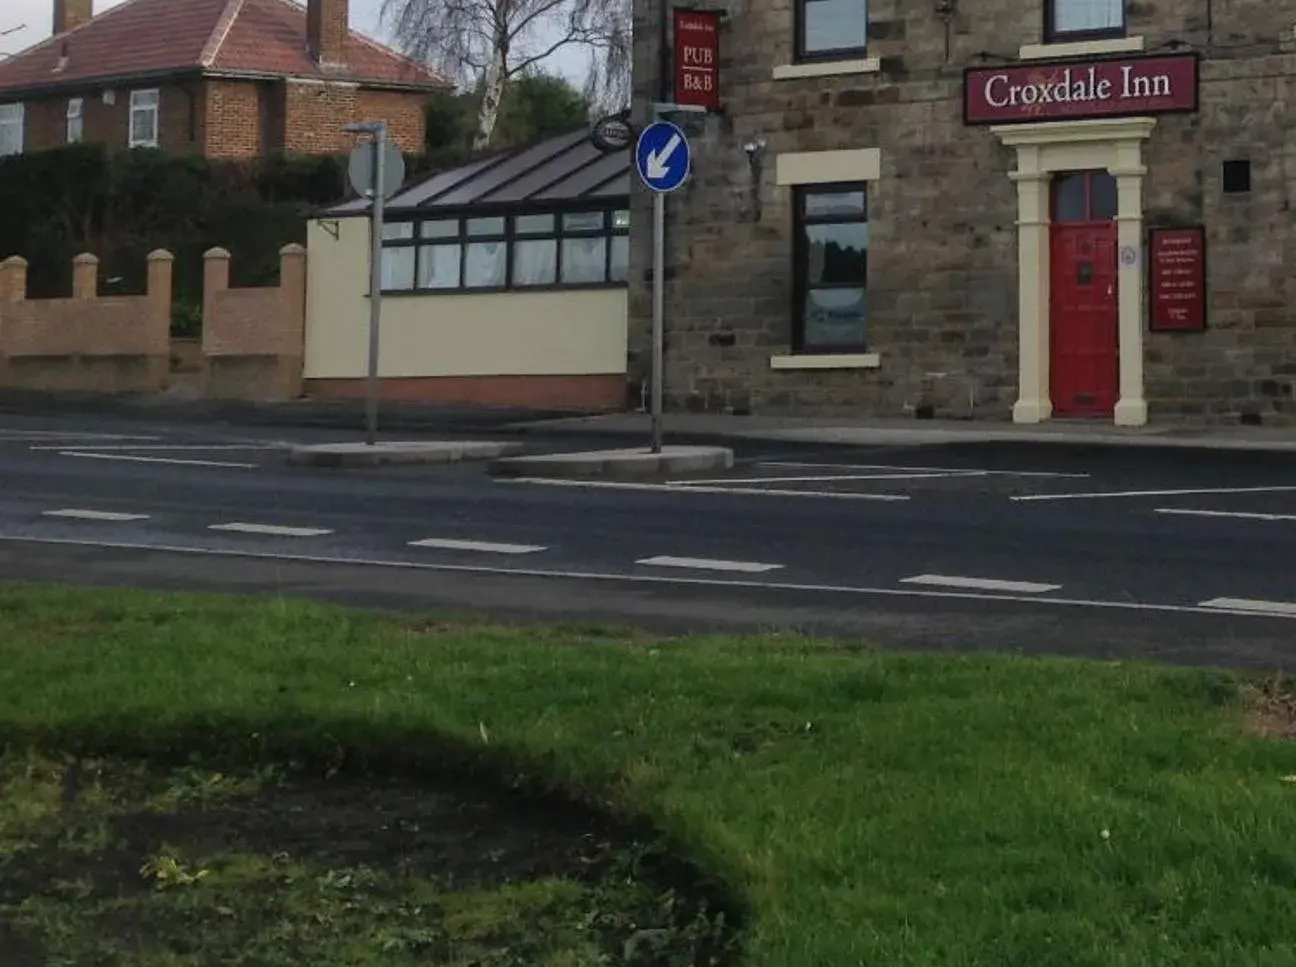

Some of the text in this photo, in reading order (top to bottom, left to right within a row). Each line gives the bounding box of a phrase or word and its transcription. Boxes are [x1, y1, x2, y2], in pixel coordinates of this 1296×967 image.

[683, 45, 713, 64] PUB
[683, 73, 713, 92] B&B
[984, 66, 1171, 107] Croxdale Inn
